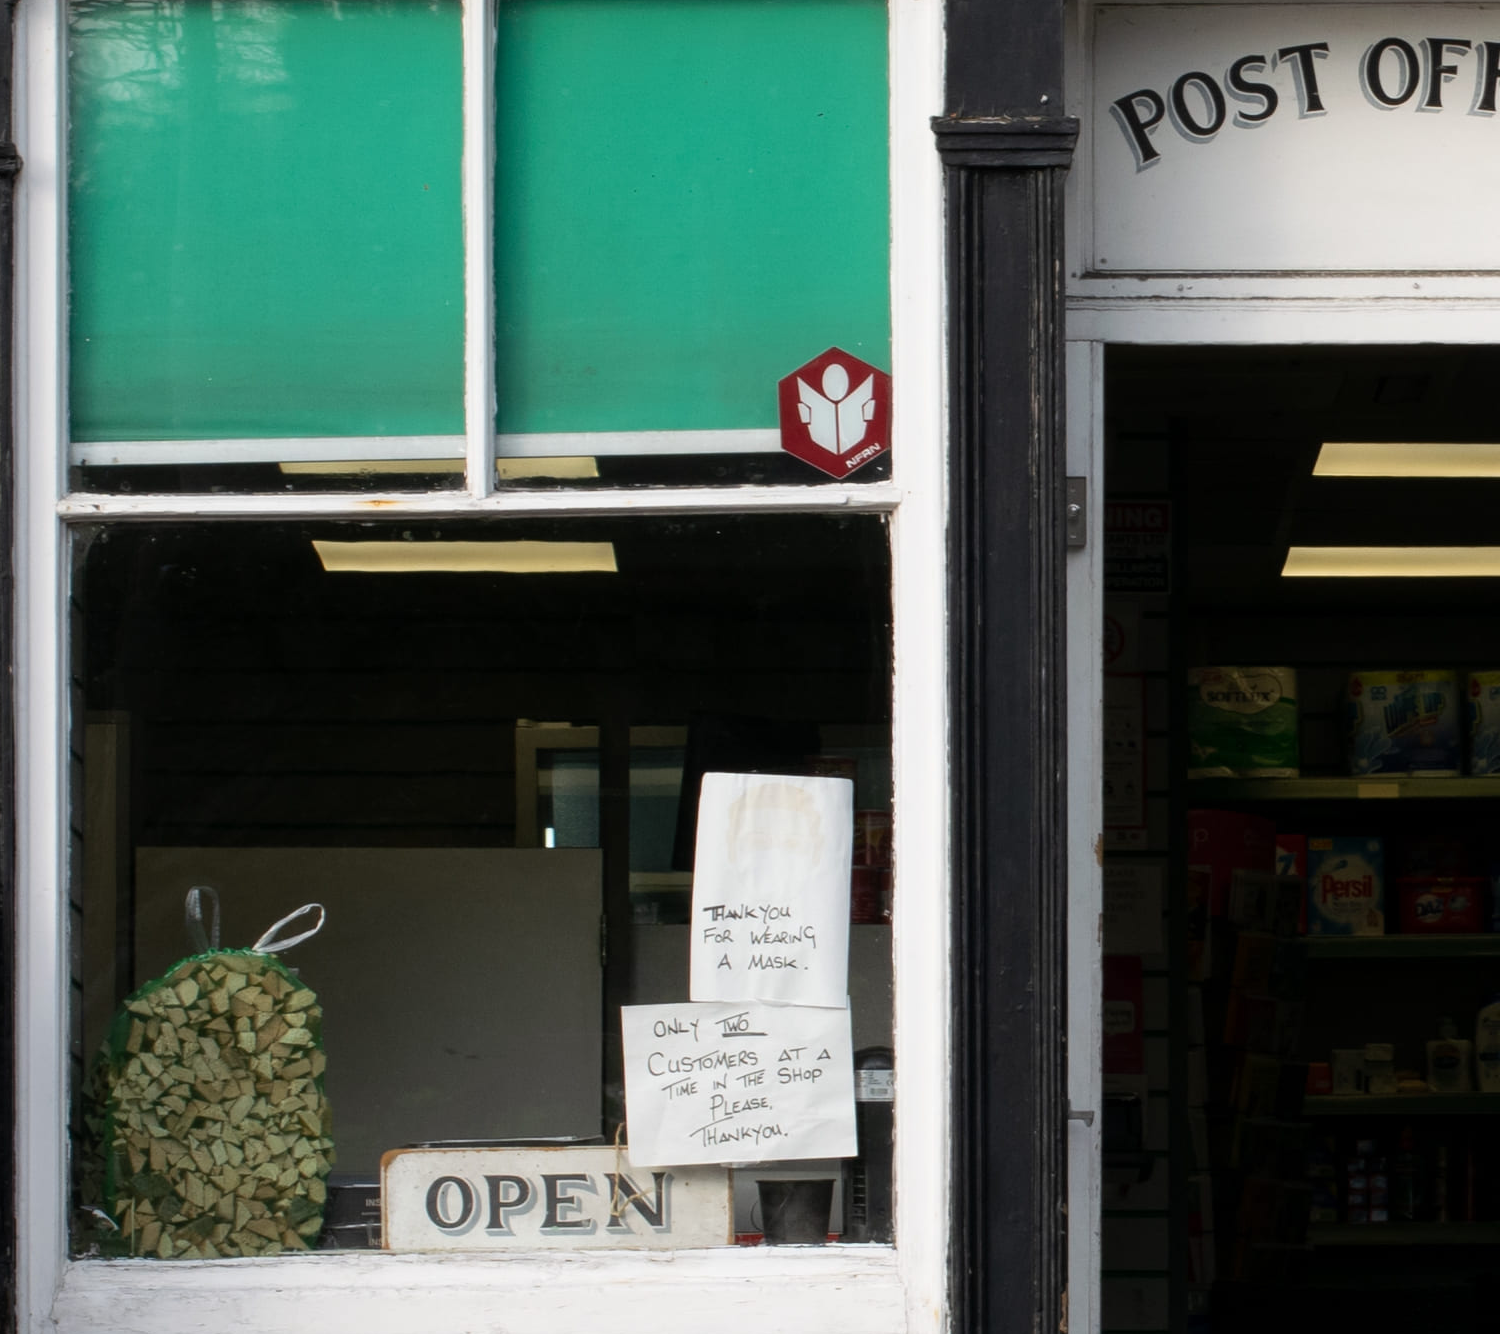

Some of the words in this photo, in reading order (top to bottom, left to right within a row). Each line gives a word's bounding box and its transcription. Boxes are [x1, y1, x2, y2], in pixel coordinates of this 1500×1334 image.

[1109, 41, 1331, 173] POST
[845, 442, 882, 469] NFRN
[1321, 873, 1373, 904] Persil
[703, 927, 735, 945] FOR
[750, 925, 816, 949] WEARING
[717, 953, 732, 970] A
[654, 1017, 700, 1043] ONLY
[715, 1011, 751, 1034] TWO
[647, 1048, 759, 1077] CUSTOMERS
[778, 1046, 808, 1063] AT
[817, 1047, 832, 1061] A
[661, 1076, 698, 1100] TIME
[713, 1073, 728, 1091] IN
[736, 1069, 766, 1090] THE
[777, 1065, 824, 1085] SHOP
[425, 1171, 673, 1238] OPEN
